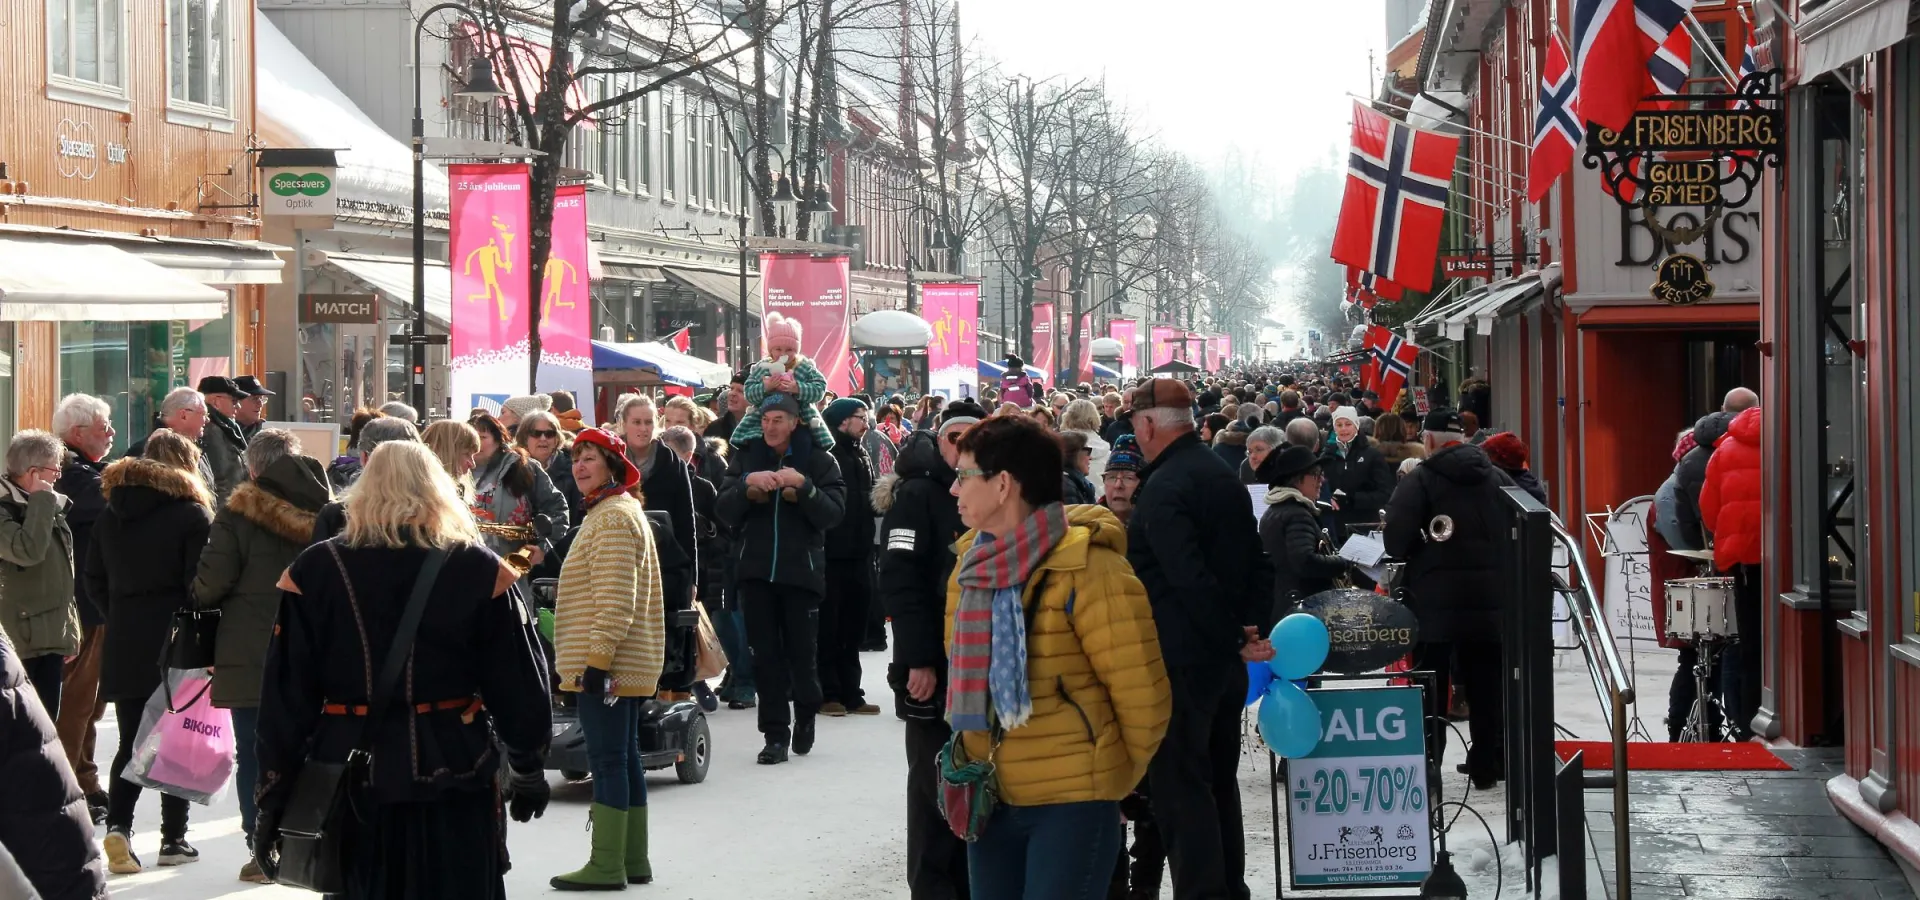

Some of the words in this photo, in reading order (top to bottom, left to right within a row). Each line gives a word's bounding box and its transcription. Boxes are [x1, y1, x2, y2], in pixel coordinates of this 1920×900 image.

[1635, 115, 1777, 146] FRISENBERG.
[1650, 163, 1715, 183] GULD
[275, 178, 325, 190] Specsavers
[458, 181, 468, 191] 25
[469, 180, 482, 191] års
[483, 182, 521, 193] jubileum
[285, 198, 314, 210] Optikk
[1650, 184, 1718, 206] SMED
[1657, 278, 1708, 304] MESTER
[315, 302, 371, 315] MATCH
[1328, 624, 1411, 645] isenberg
[1320, 706, 1406, 742] ALG
[1308, 841, 1417, 862] J.Frisenberg
[1327, 872, 1399, 883] www.frisenberg.no
